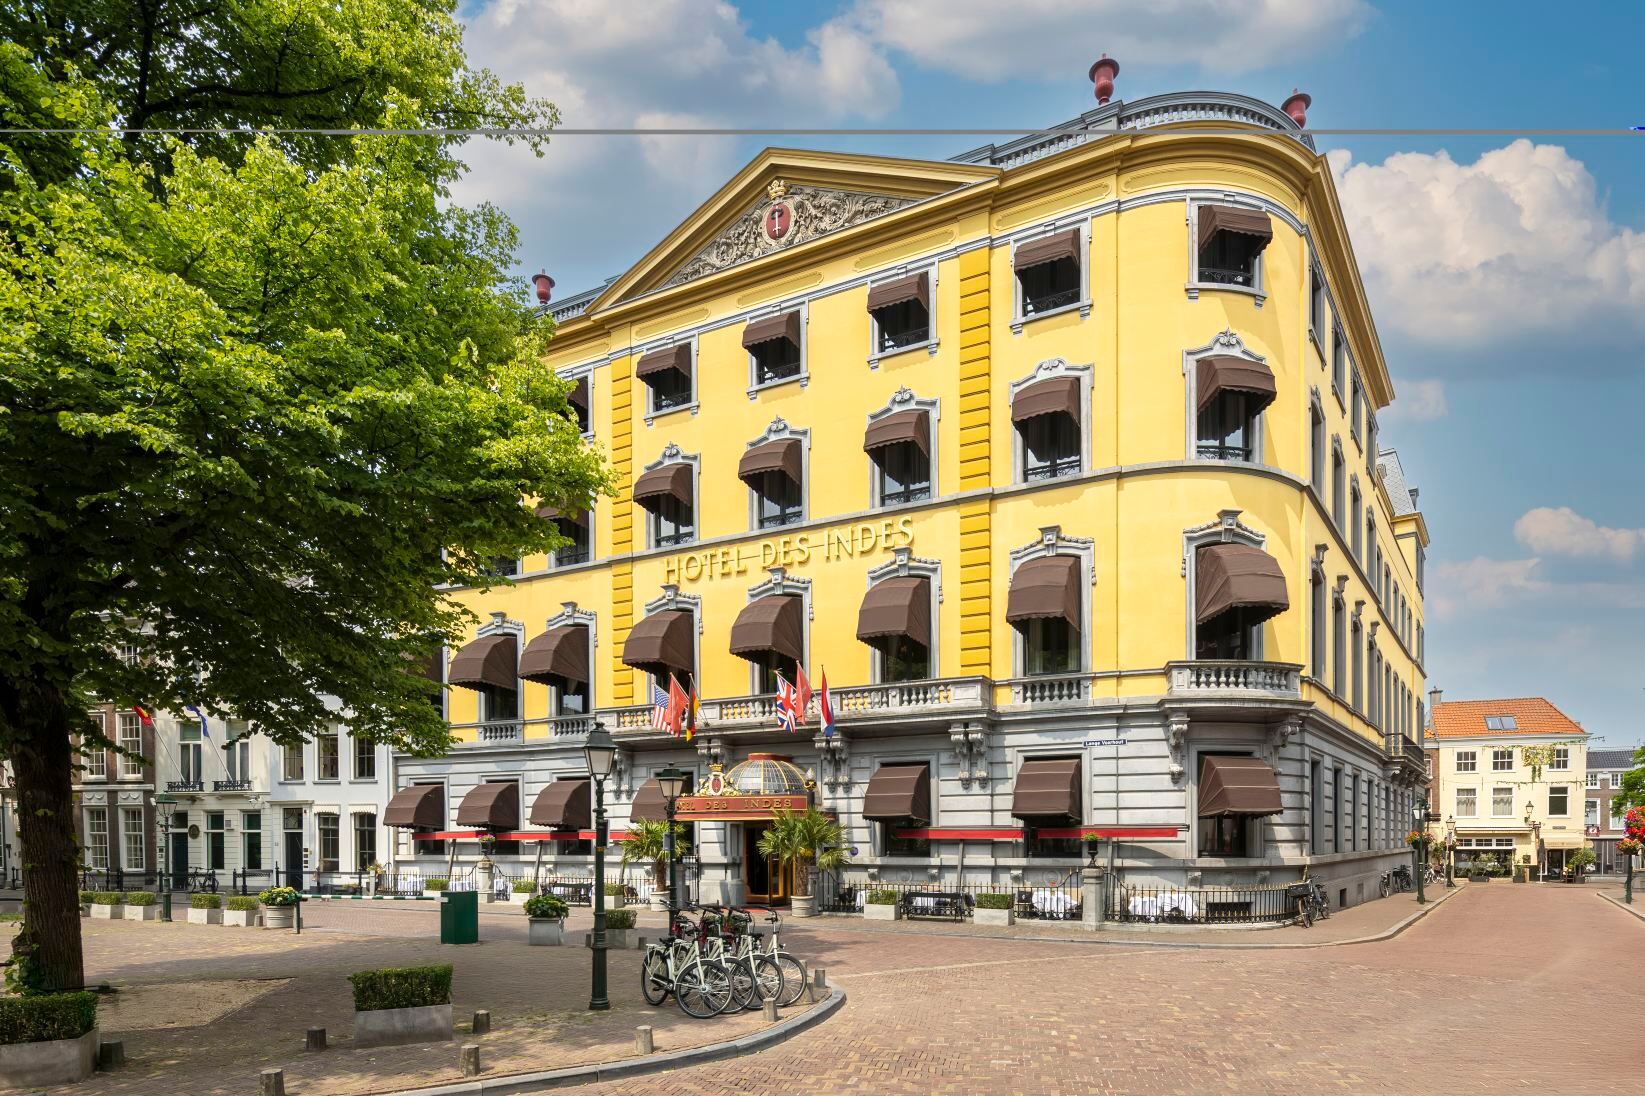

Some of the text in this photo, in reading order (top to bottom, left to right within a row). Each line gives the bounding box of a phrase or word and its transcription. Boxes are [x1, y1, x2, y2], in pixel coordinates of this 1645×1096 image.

[663, 515, 914, 583] HOTEL DES INDES
[676, 799, 791, 811] OTEL DES INDES
